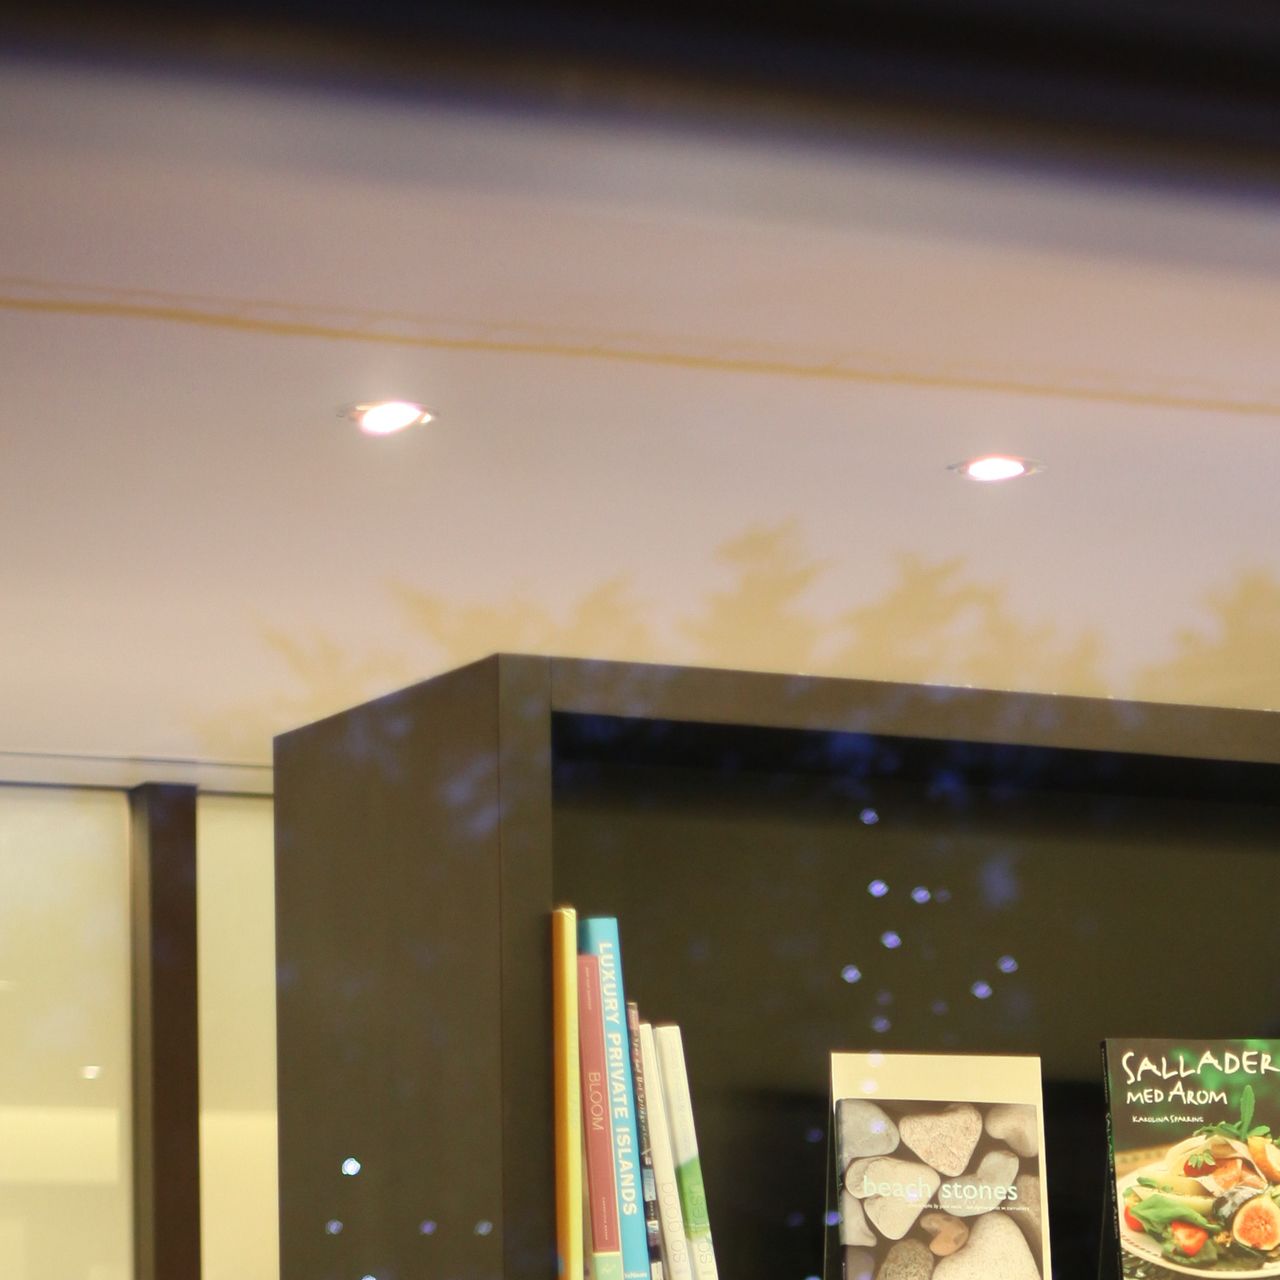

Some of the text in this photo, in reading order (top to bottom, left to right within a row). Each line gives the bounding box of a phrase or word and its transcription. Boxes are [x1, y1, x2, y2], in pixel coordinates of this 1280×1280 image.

[586, 1071, 606, 1131] BLOOM
[597, 942, 638, 1217] LUXURY PRIVATE ISLANDS
[1126, 1080, 1229, 1106] MED AROM
[863, 1174, 1020, 1203] beach stones
